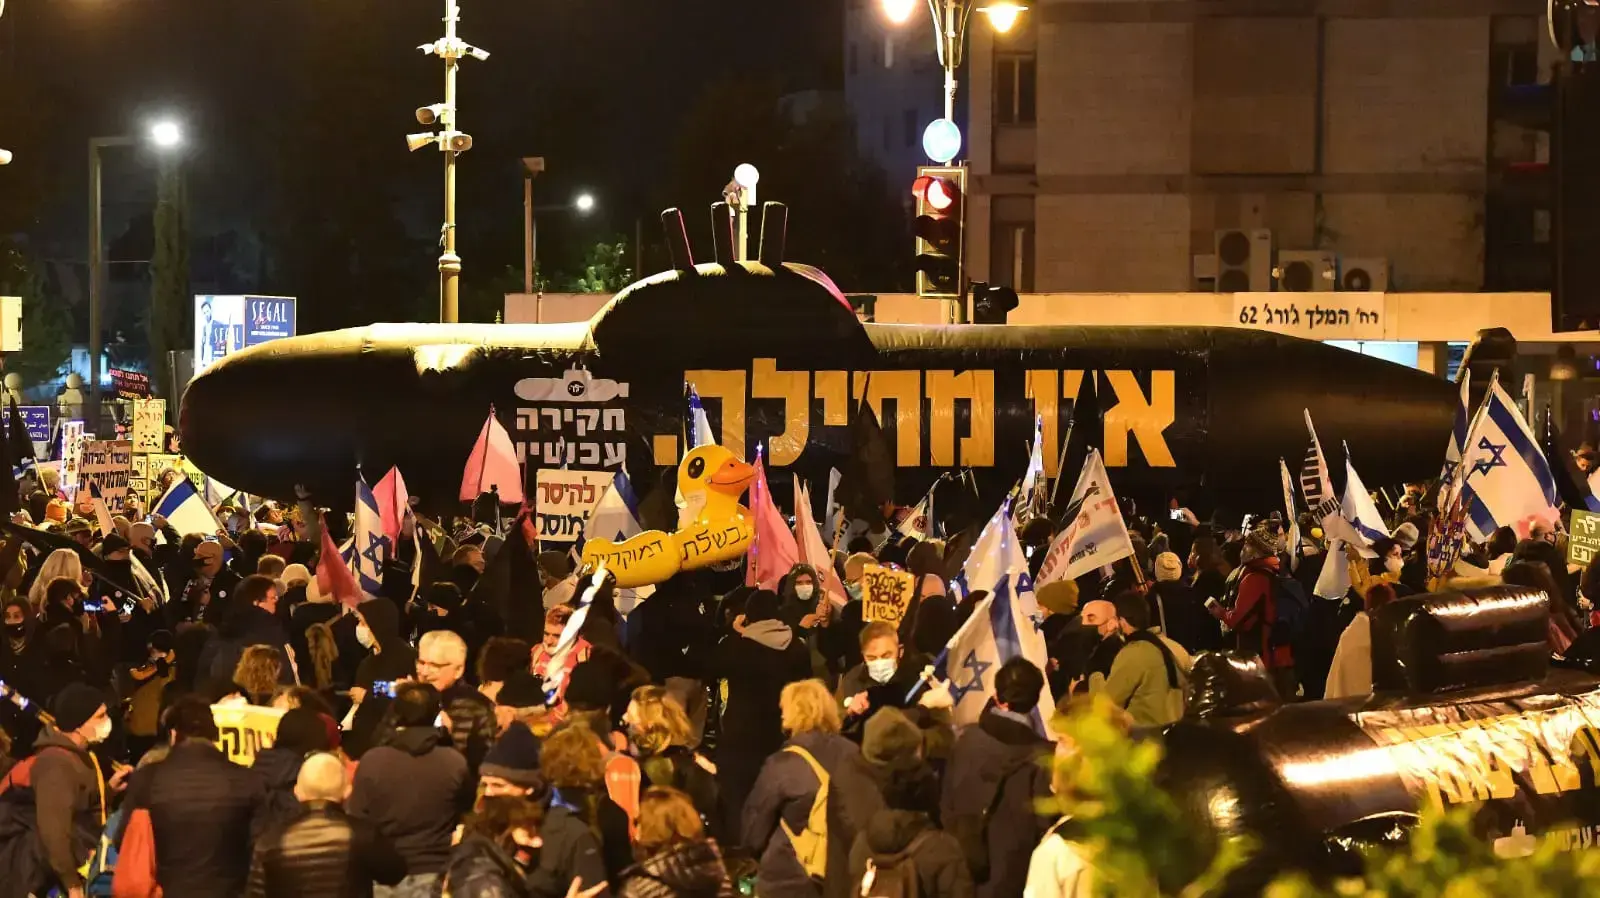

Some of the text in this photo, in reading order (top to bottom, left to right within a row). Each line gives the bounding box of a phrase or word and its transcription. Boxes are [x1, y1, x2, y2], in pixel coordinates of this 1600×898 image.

[252, 301, 287, 322] SEGAL
[1239, 303, 1379, 330] רח' המלך ג'ורג' 62
[516, 408, 626, 436] חקירה
[516, 441, 626, 467] עכשיו
